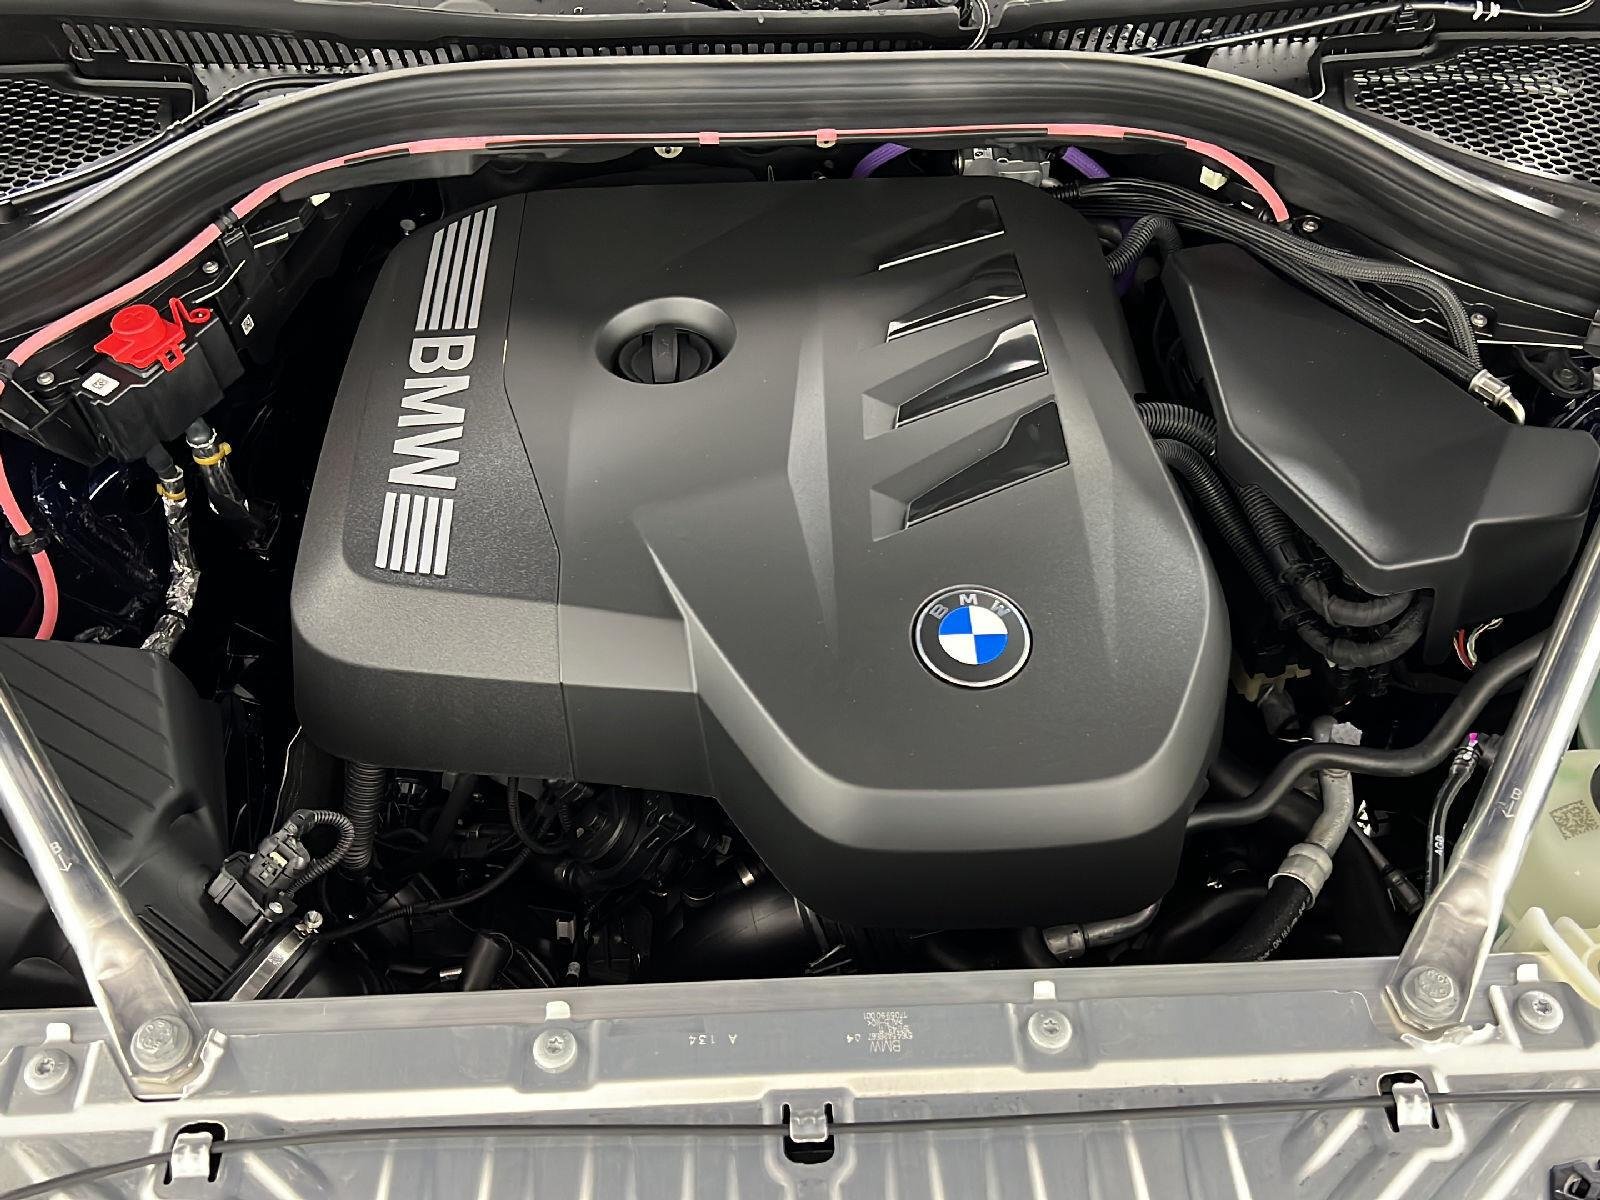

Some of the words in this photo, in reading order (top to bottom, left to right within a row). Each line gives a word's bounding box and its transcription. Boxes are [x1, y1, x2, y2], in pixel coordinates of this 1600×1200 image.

[387, 334, 476, 490] BMW
[929, 593, 1011, 620] BMW
[688, 1034, 716, 1046] 134
[728, 1033, 738, 1046] A
[869, 1039, 901, 1053] BMW
